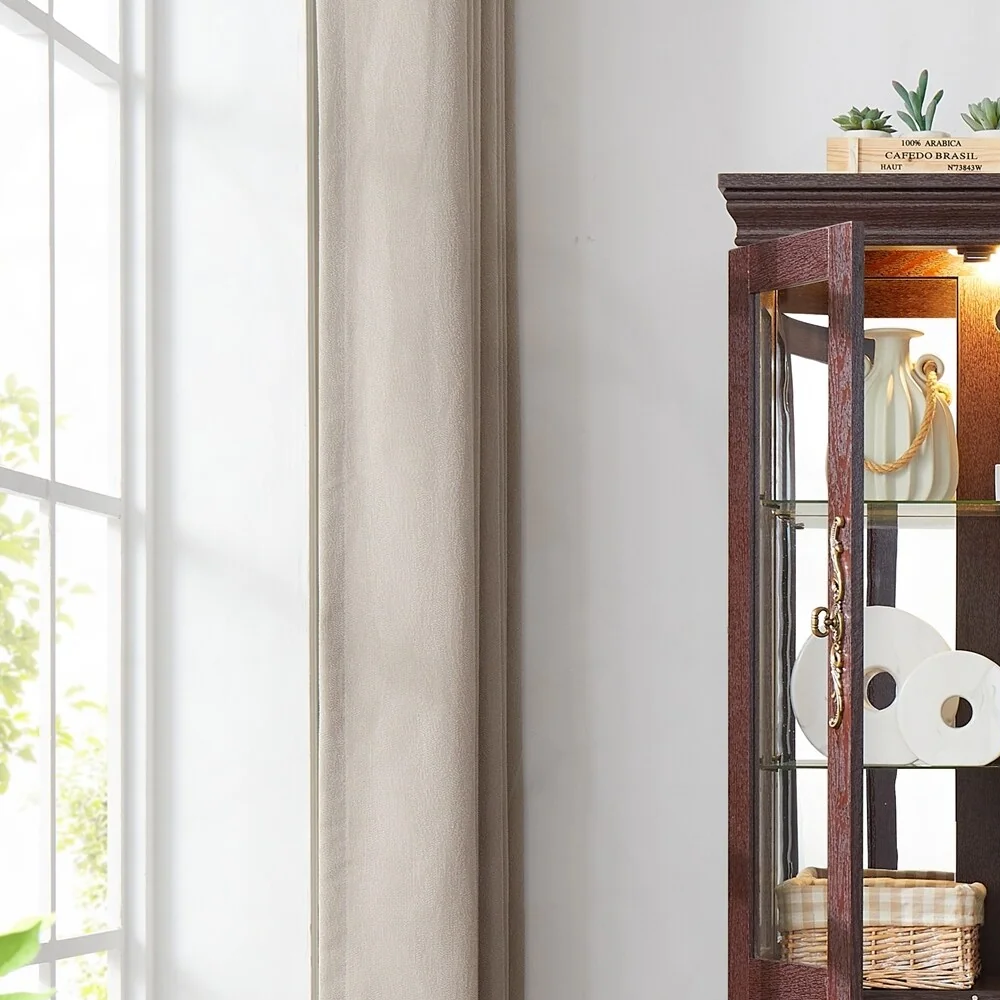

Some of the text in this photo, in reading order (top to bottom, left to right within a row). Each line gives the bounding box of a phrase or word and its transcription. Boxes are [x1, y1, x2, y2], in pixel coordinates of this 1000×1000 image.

[901, 139, 962, 147] 100% ARABICA
[935, 151, 978, 160] BRASIL
[880, 163, 903, 171] HAUT
